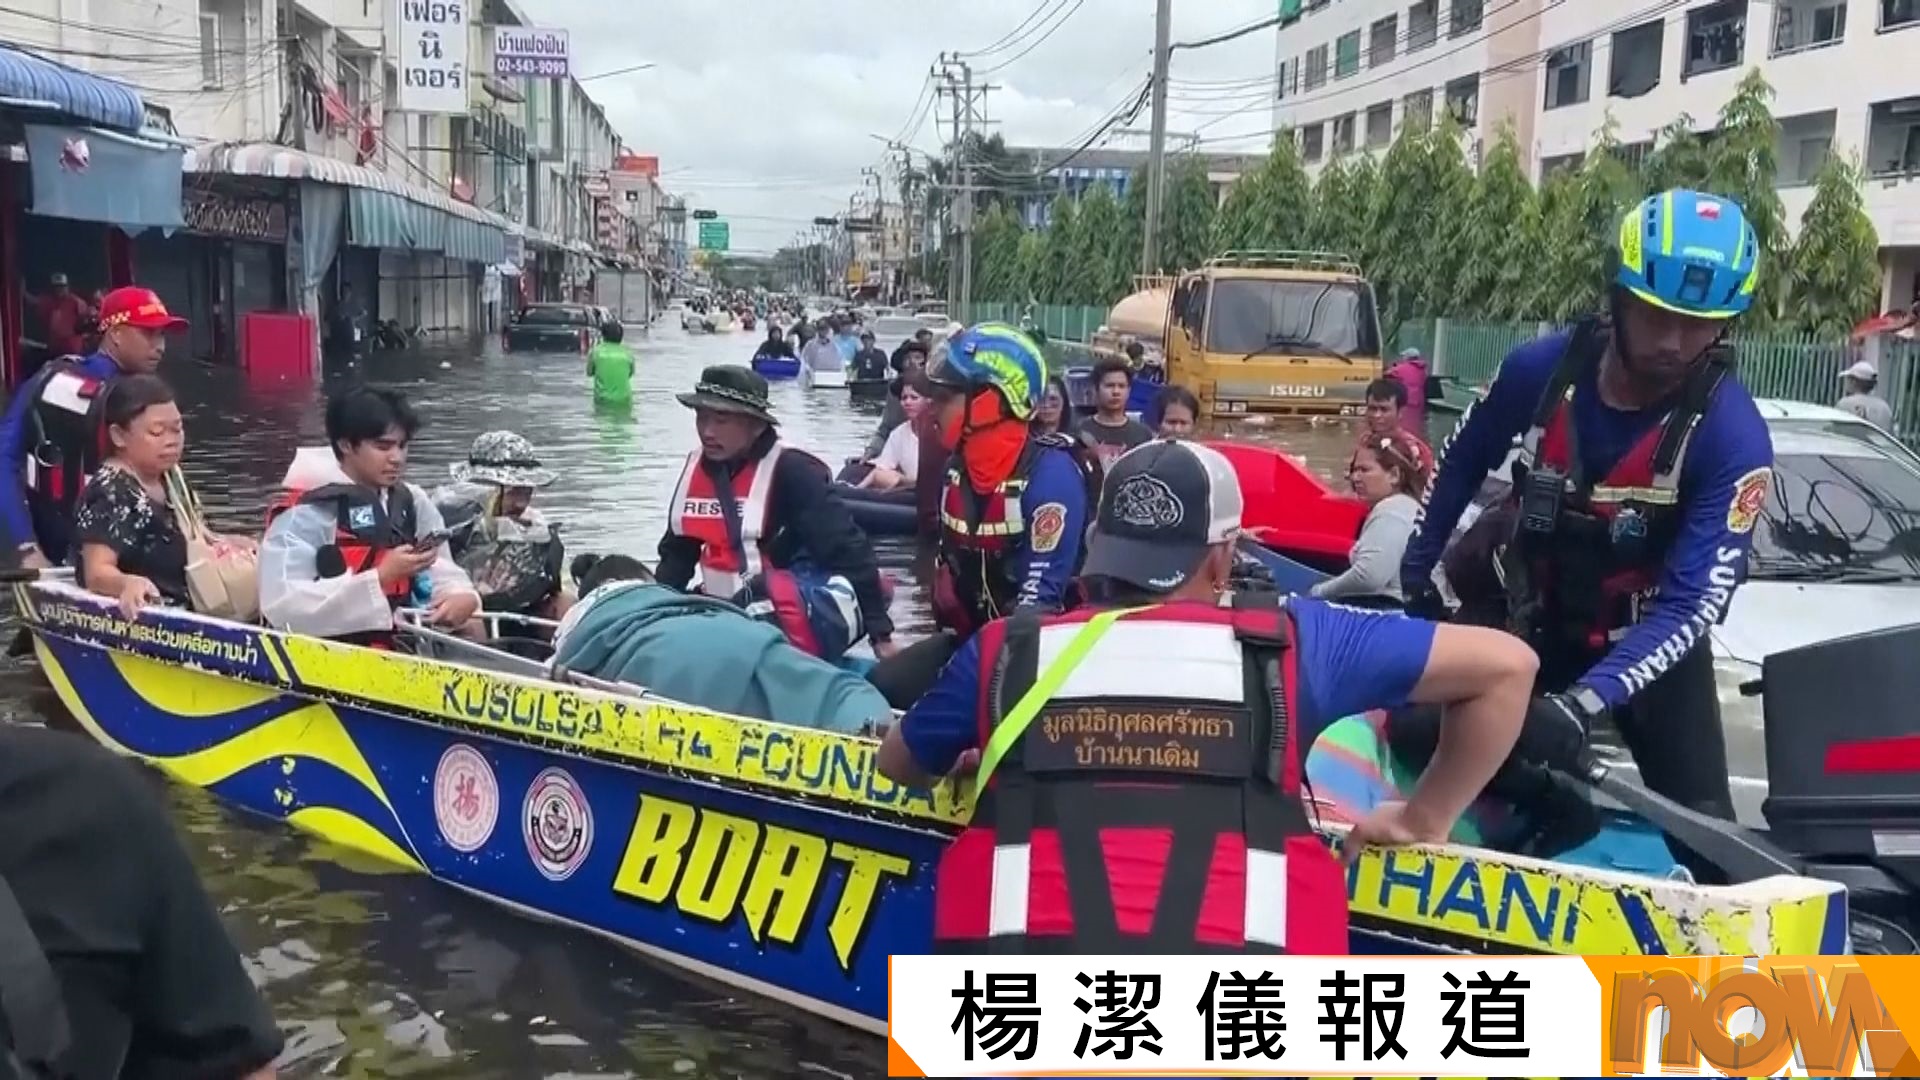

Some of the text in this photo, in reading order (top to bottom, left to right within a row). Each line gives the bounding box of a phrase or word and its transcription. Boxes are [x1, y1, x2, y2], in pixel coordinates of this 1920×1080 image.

[418, 31, 443, 59] นิ
[405, 63, 461, 89] เจอร์
[497, 57, 566, 75] 02-543-9099
[1270, 384, 1326, 398] ISUZU
[684, 500, 745, 516] RESE
[1043, 707, 1234, 744] มูลนิธิกุศลศรัทธา
[1075, 737, 1200, 769] บ้านนาเดิม
[612, 793, 911, 970] BOAT
